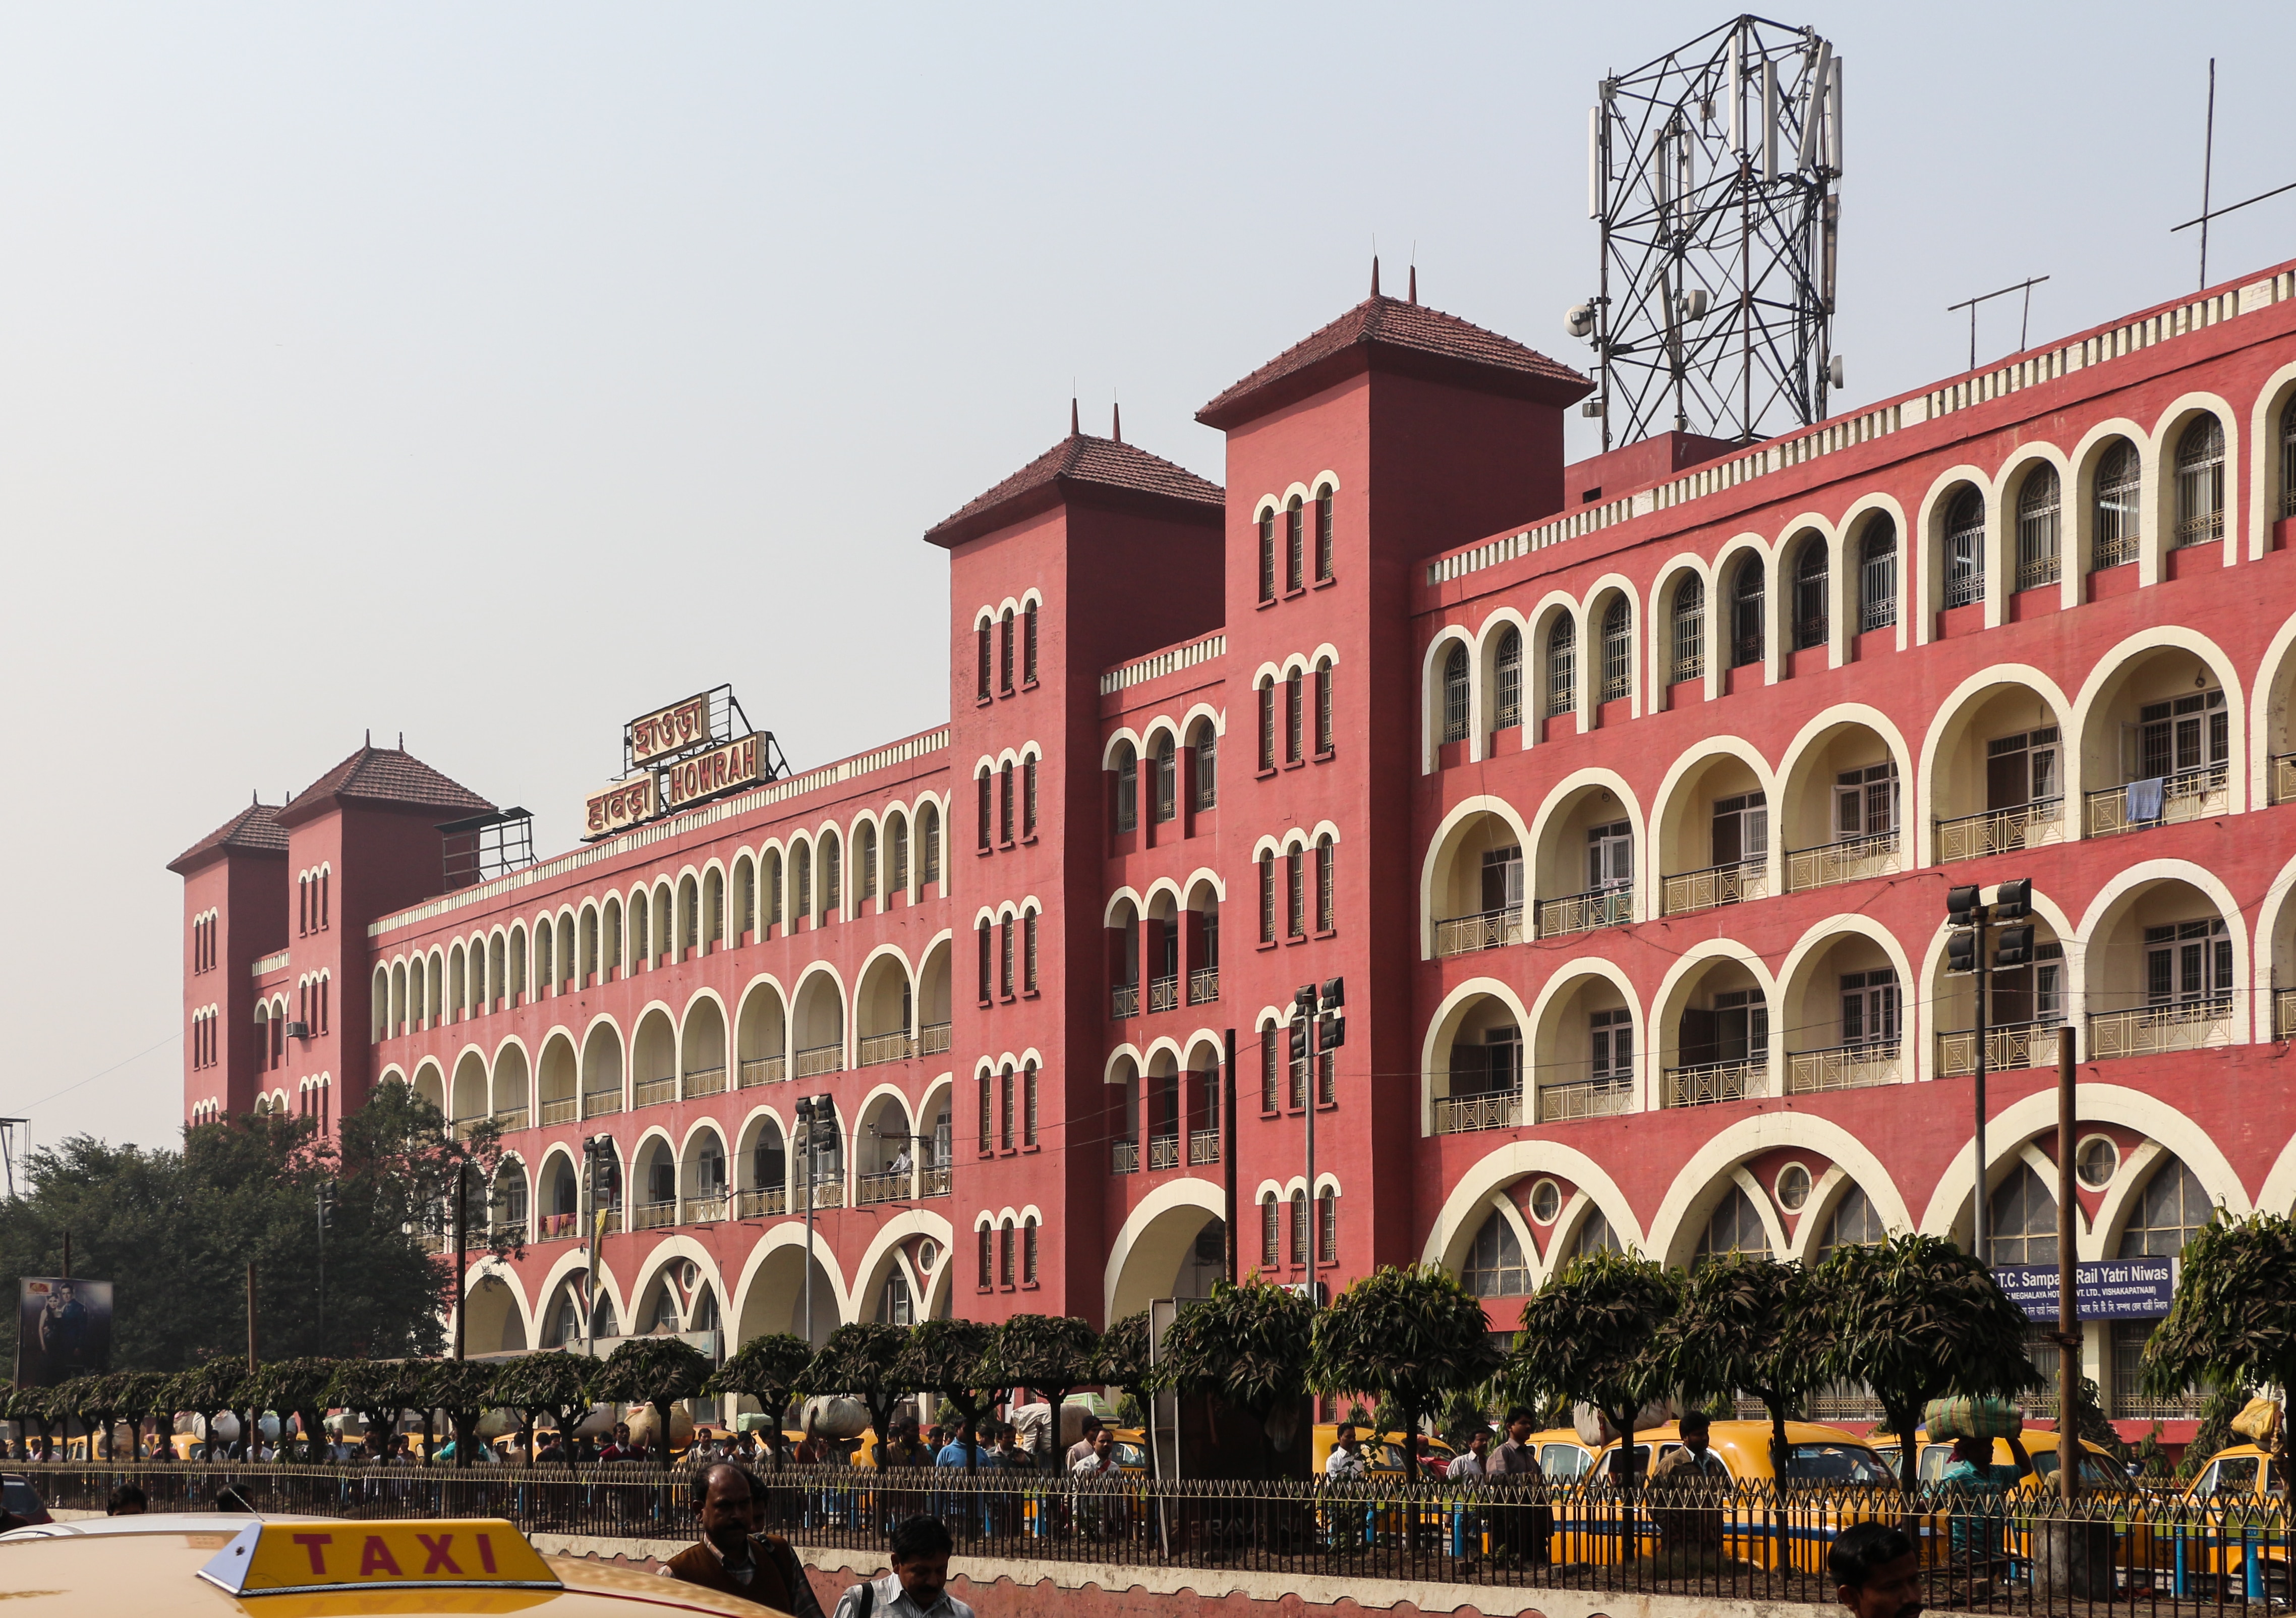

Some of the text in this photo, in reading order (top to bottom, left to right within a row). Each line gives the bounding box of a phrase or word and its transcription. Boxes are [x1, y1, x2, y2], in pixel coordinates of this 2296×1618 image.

[635, 701, 702, 755] হাওড়া
[672, 740, 756, 802] HOWRAH
[587, 778, 652, 830] हावड़ा
[2011, 1291, 2047, 1300] MEGHALAYA
[2101, 1286, 2156, 1297] VISHAKAPATNAM)
[2076, 1268, 2098, 1285] Rail
[2100, 1266, 2128, 1284] Yatri
[2132, 1265, 2168, 1281] Niwas
[294, 1533, 497, 1576] TAXI
